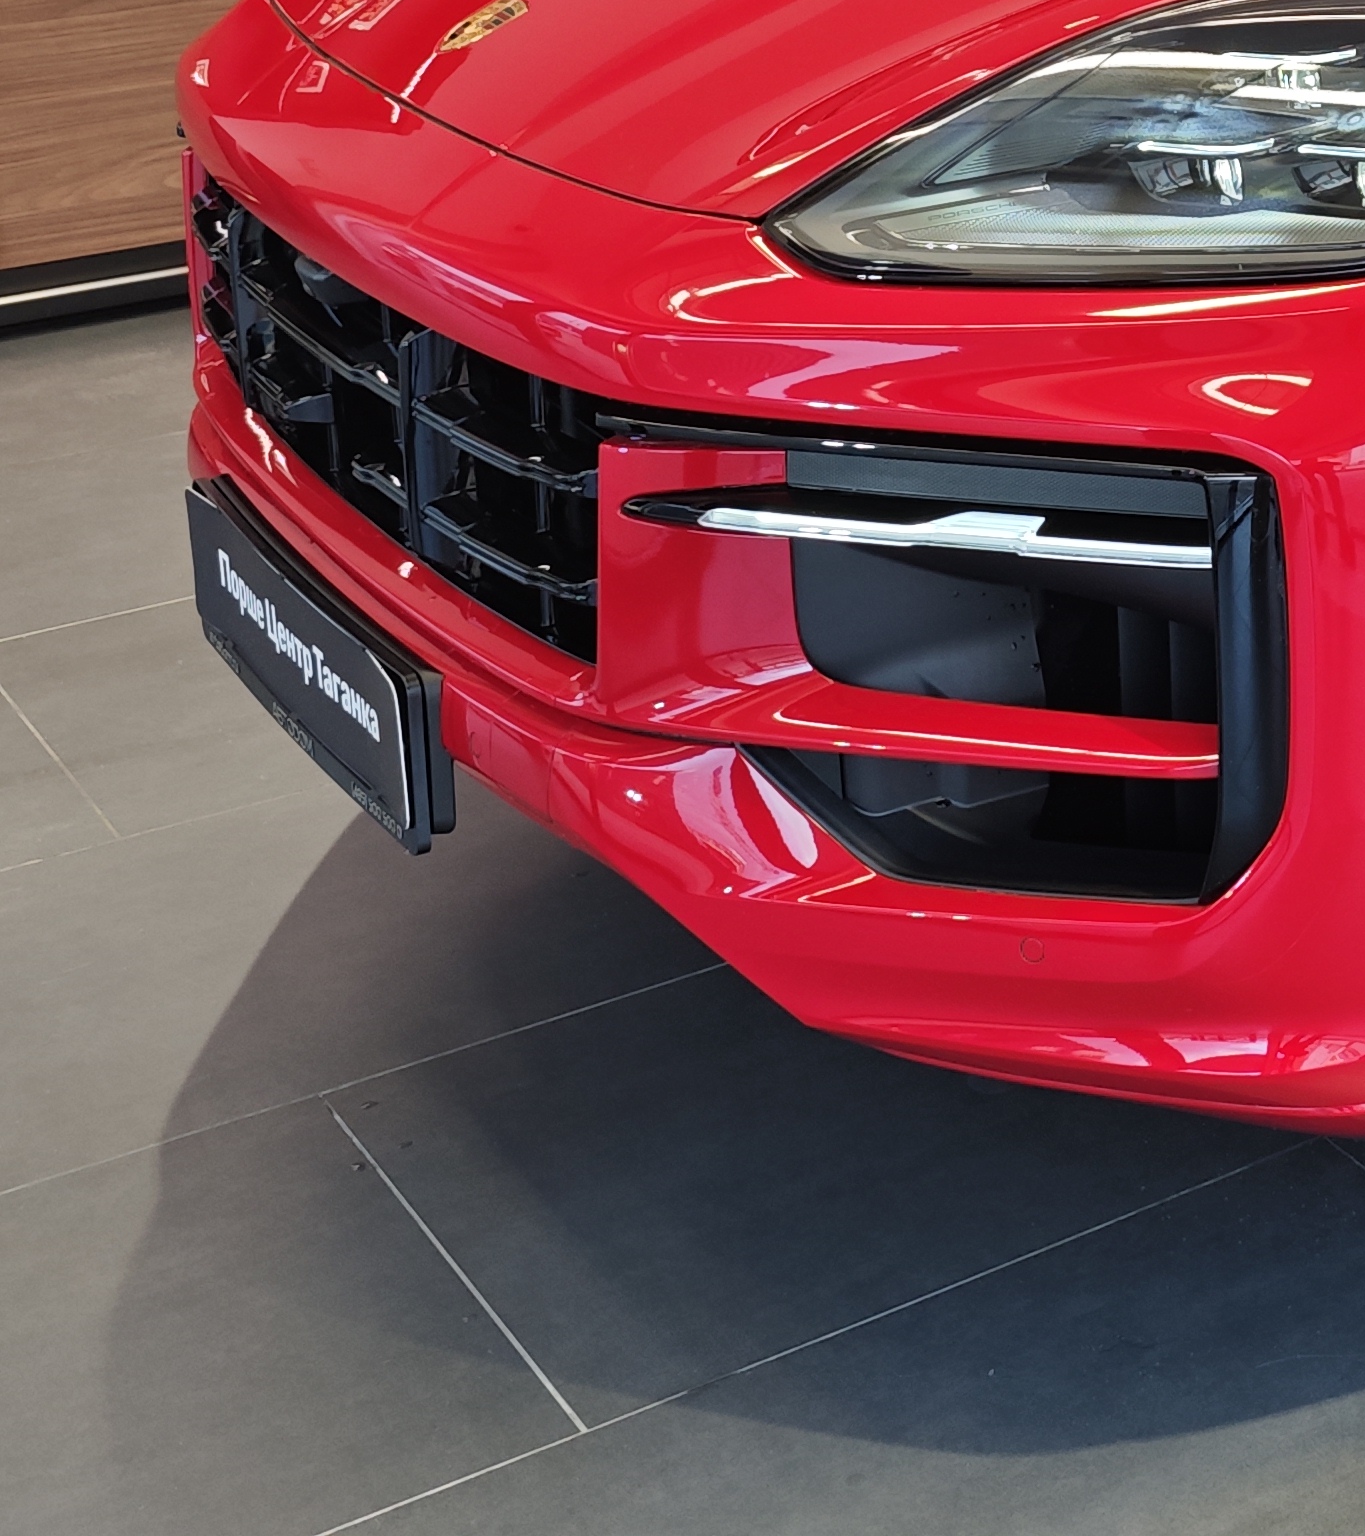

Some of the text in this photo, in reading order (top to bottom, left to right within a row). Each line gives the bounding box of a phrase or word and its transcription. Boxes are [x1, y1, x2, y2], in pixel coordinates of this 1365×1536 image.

[217, 548, 265, 631] Порше
[264, 598, 314, 685] Центр
[311, 645, 381, 743] Таганка
